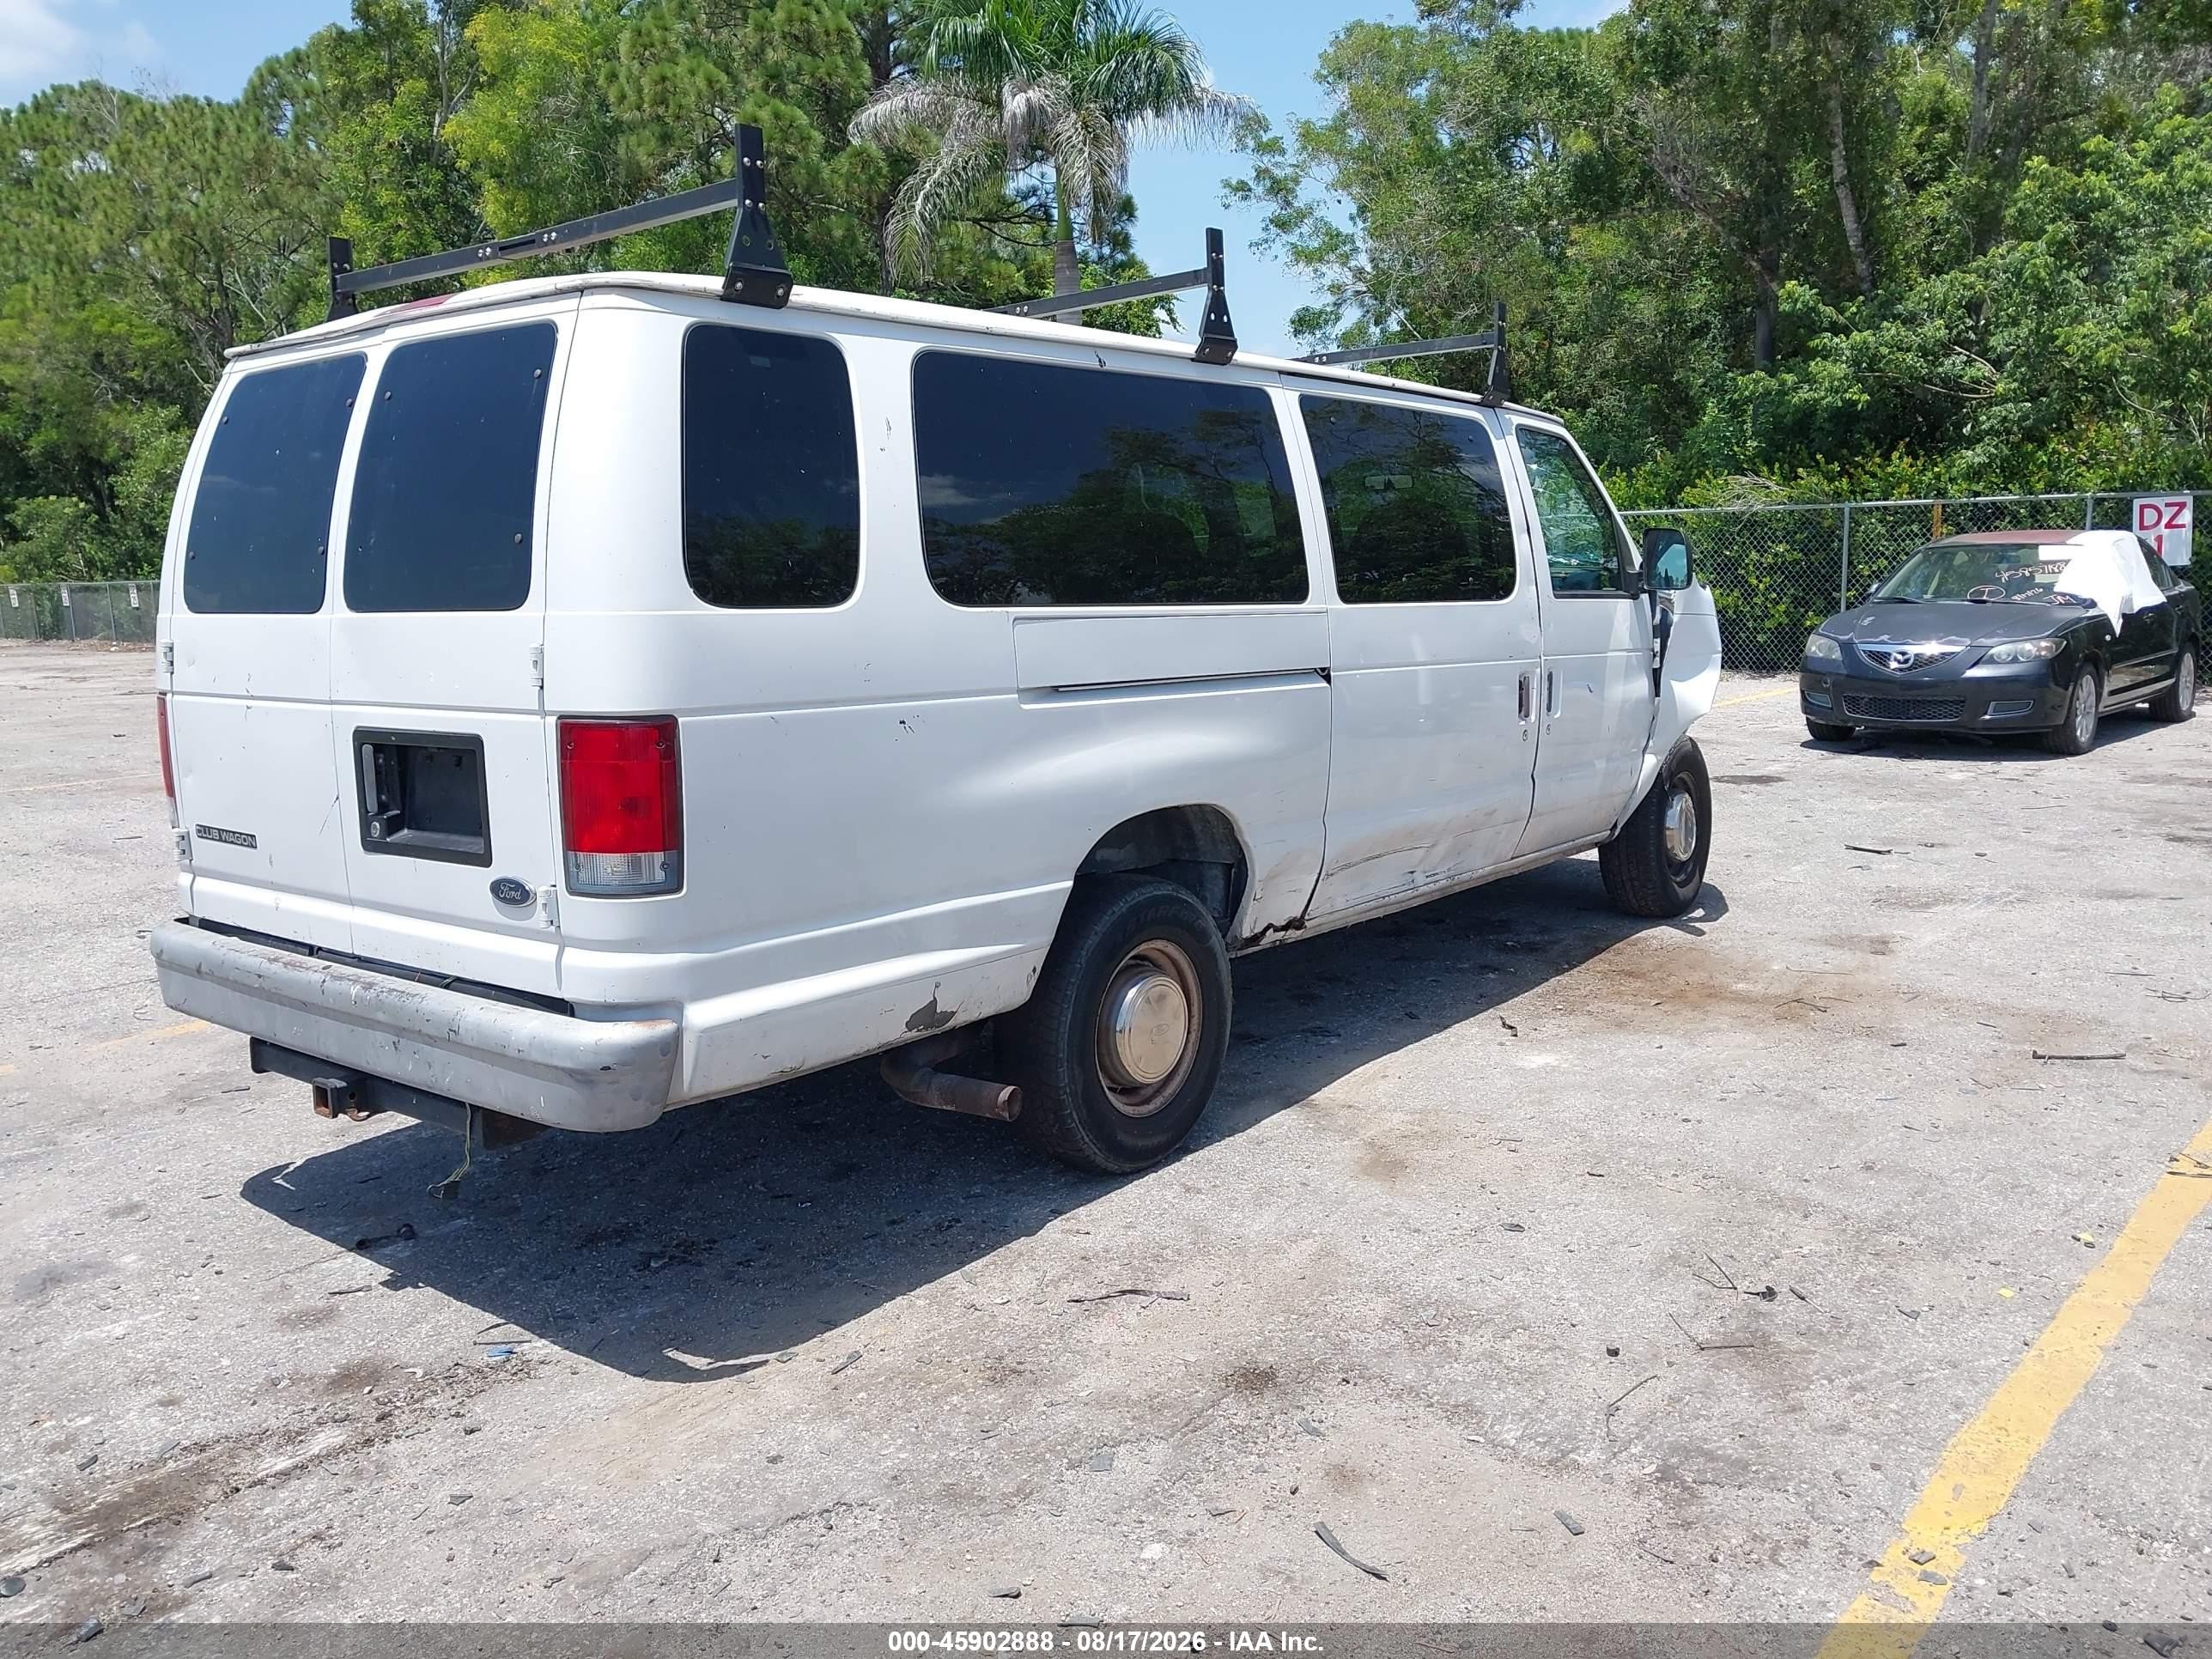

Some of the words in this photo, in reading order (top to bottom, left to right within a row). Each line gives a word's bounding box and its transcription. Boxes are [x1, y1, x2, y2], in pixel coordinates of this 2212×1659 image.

[2138, 501, 2187, 532] DZ
[196, 826, 220, 840] CLUB
[220, 830, 257, 848] WAGON
[499, 883, 522, 900] Ford
